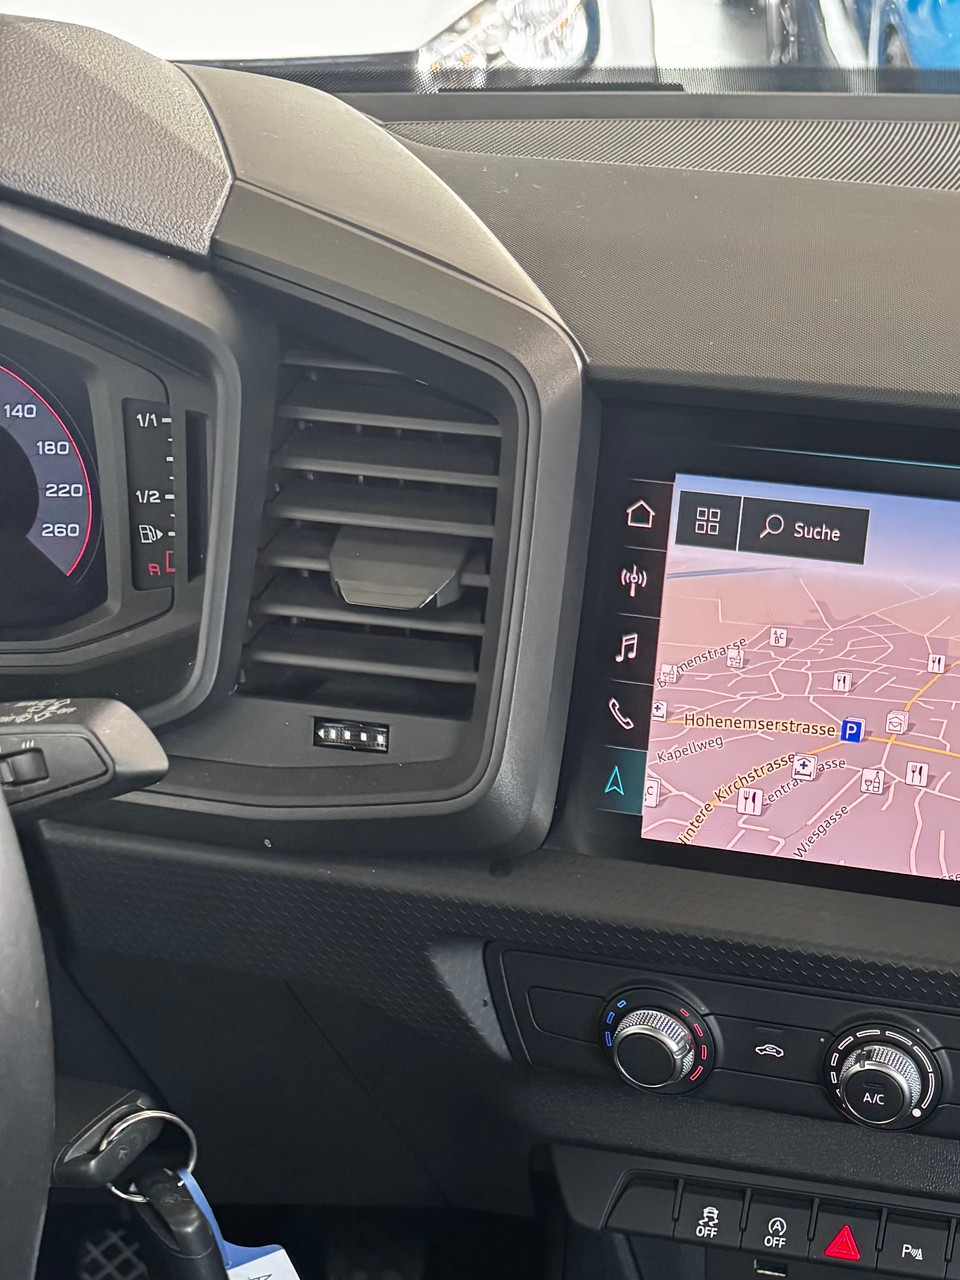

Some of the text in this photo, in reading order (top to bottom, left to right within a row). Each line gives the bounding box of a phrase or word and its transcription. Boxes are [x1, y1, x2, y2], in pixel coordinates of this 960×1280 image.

[4, 404, 37, 418] 140
[136, 413, 158, 427] 1/1
[36, 441, 70, 455] 180
[45, 484, 83, 497] 220
[136, 490, 161, 503] 1/2
[42, 524, 80, 537] 260
[794, 522, 841, 542] Suche
[684, 713, 836, 737] Hohenemserstrasse
[656, 737, 724, 764] Kapellweg
[714, 752, 796, 803] Kirchstrasse
[793, 806, 849, 858] Wiesgasse
[863, 1092, 885, 1105] A/C
[696, 1226, 718, 1239] OFF
[764, 1236, 786, 1249] OFF
